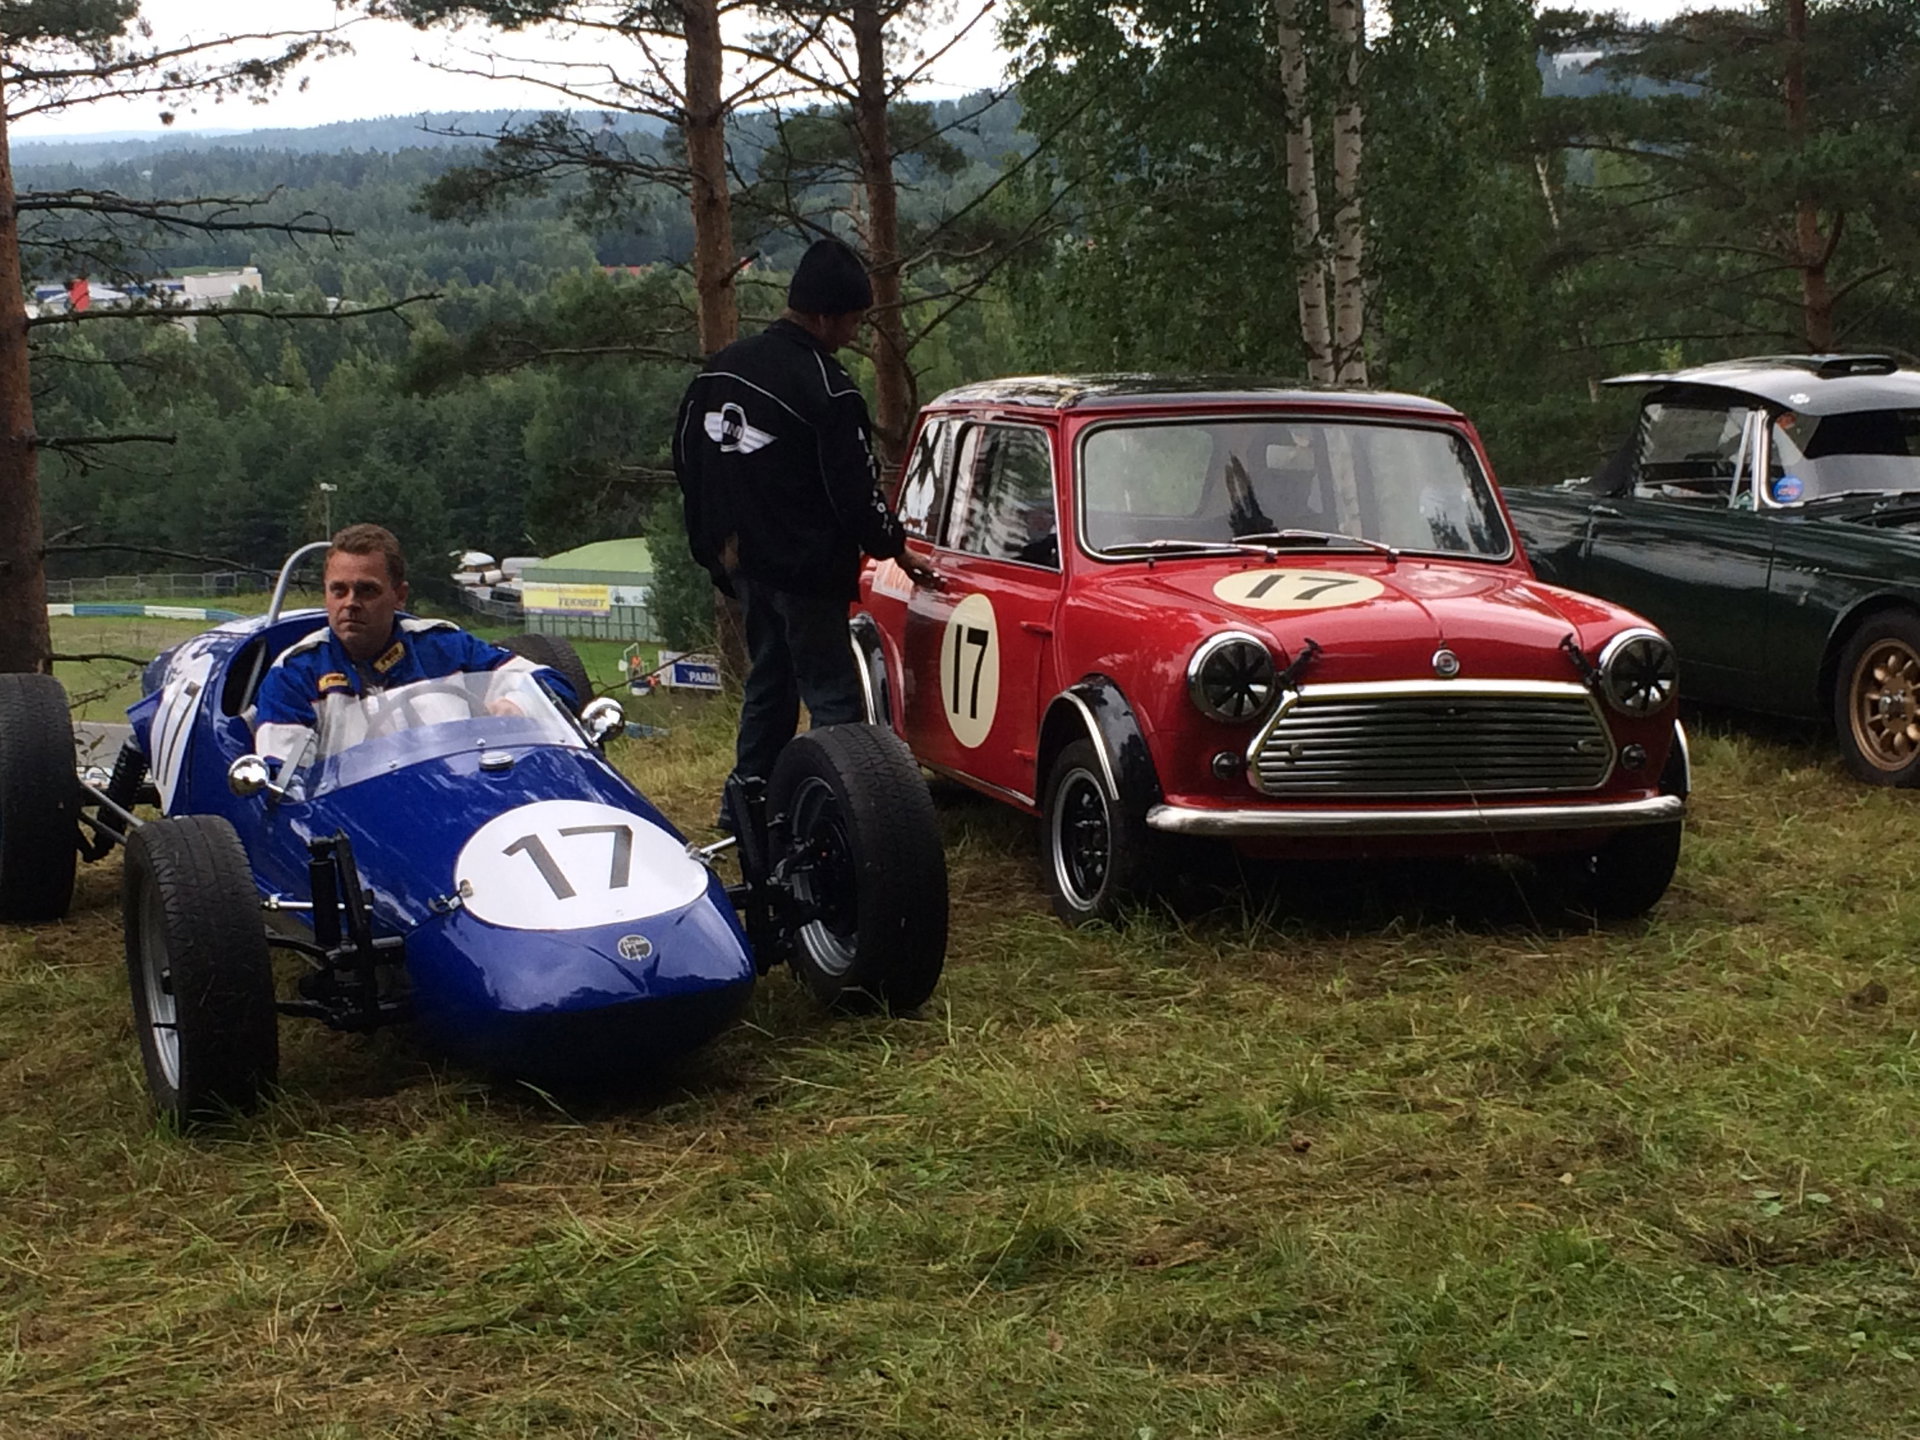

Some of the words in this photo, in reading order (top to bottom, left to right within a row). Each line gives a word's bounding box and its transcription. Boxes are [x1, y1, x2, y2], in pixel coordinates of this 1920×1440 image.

[1245, 574, 1359, 600] 17
[953, 624, 989, 719] 17
[501, 824, 634, 900] 17
